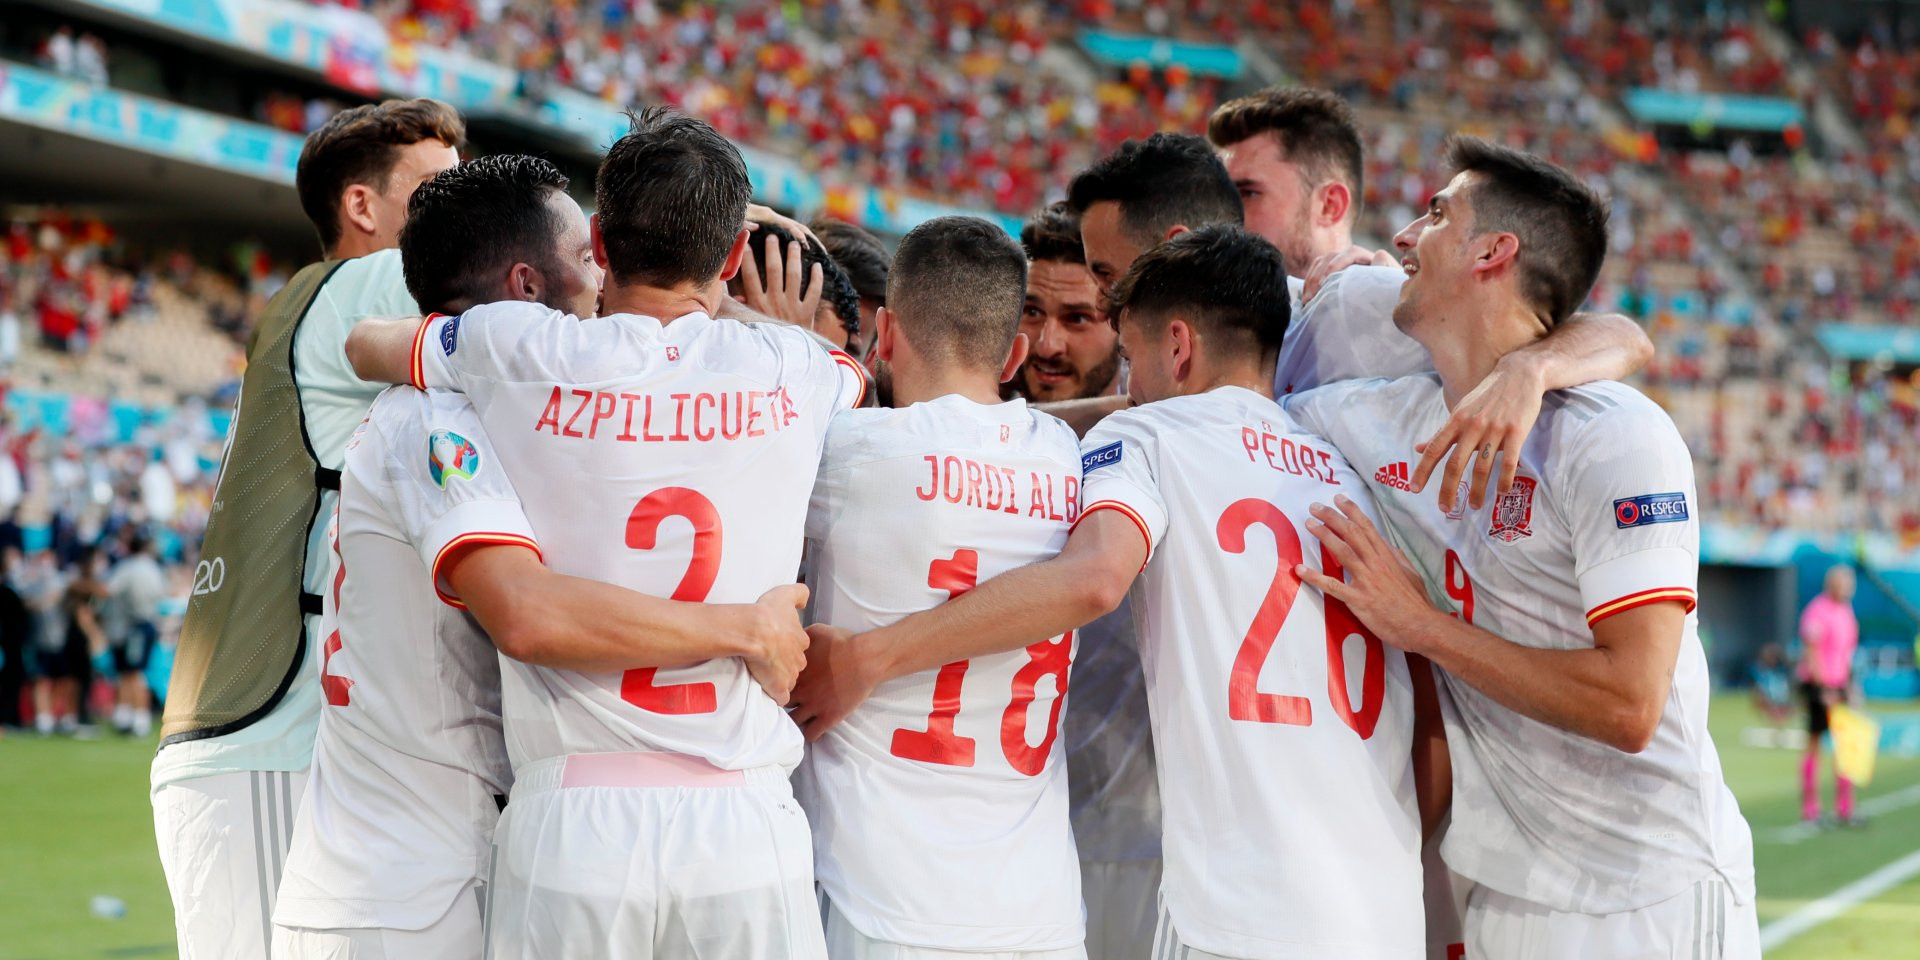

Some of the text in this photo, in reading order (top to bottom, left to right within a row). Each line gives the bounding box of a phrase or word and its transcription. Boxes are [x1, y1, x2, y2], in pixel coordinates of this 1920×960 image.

[535, 385, 799, 442] AZPILICUETA
[916, 455, 1083, 524] JORDI ALB
[1374, 472, 1411, 492] adidas
[1641, 501, 1686, 517] RESPECT
[193, 557, 225, 595] 20
[620, 486, 723, 715] 2
[1445, 548, 1475, 626] 9
[1216, 497, 1385, 740] 26
[890, 548, 1074, 777] 18
